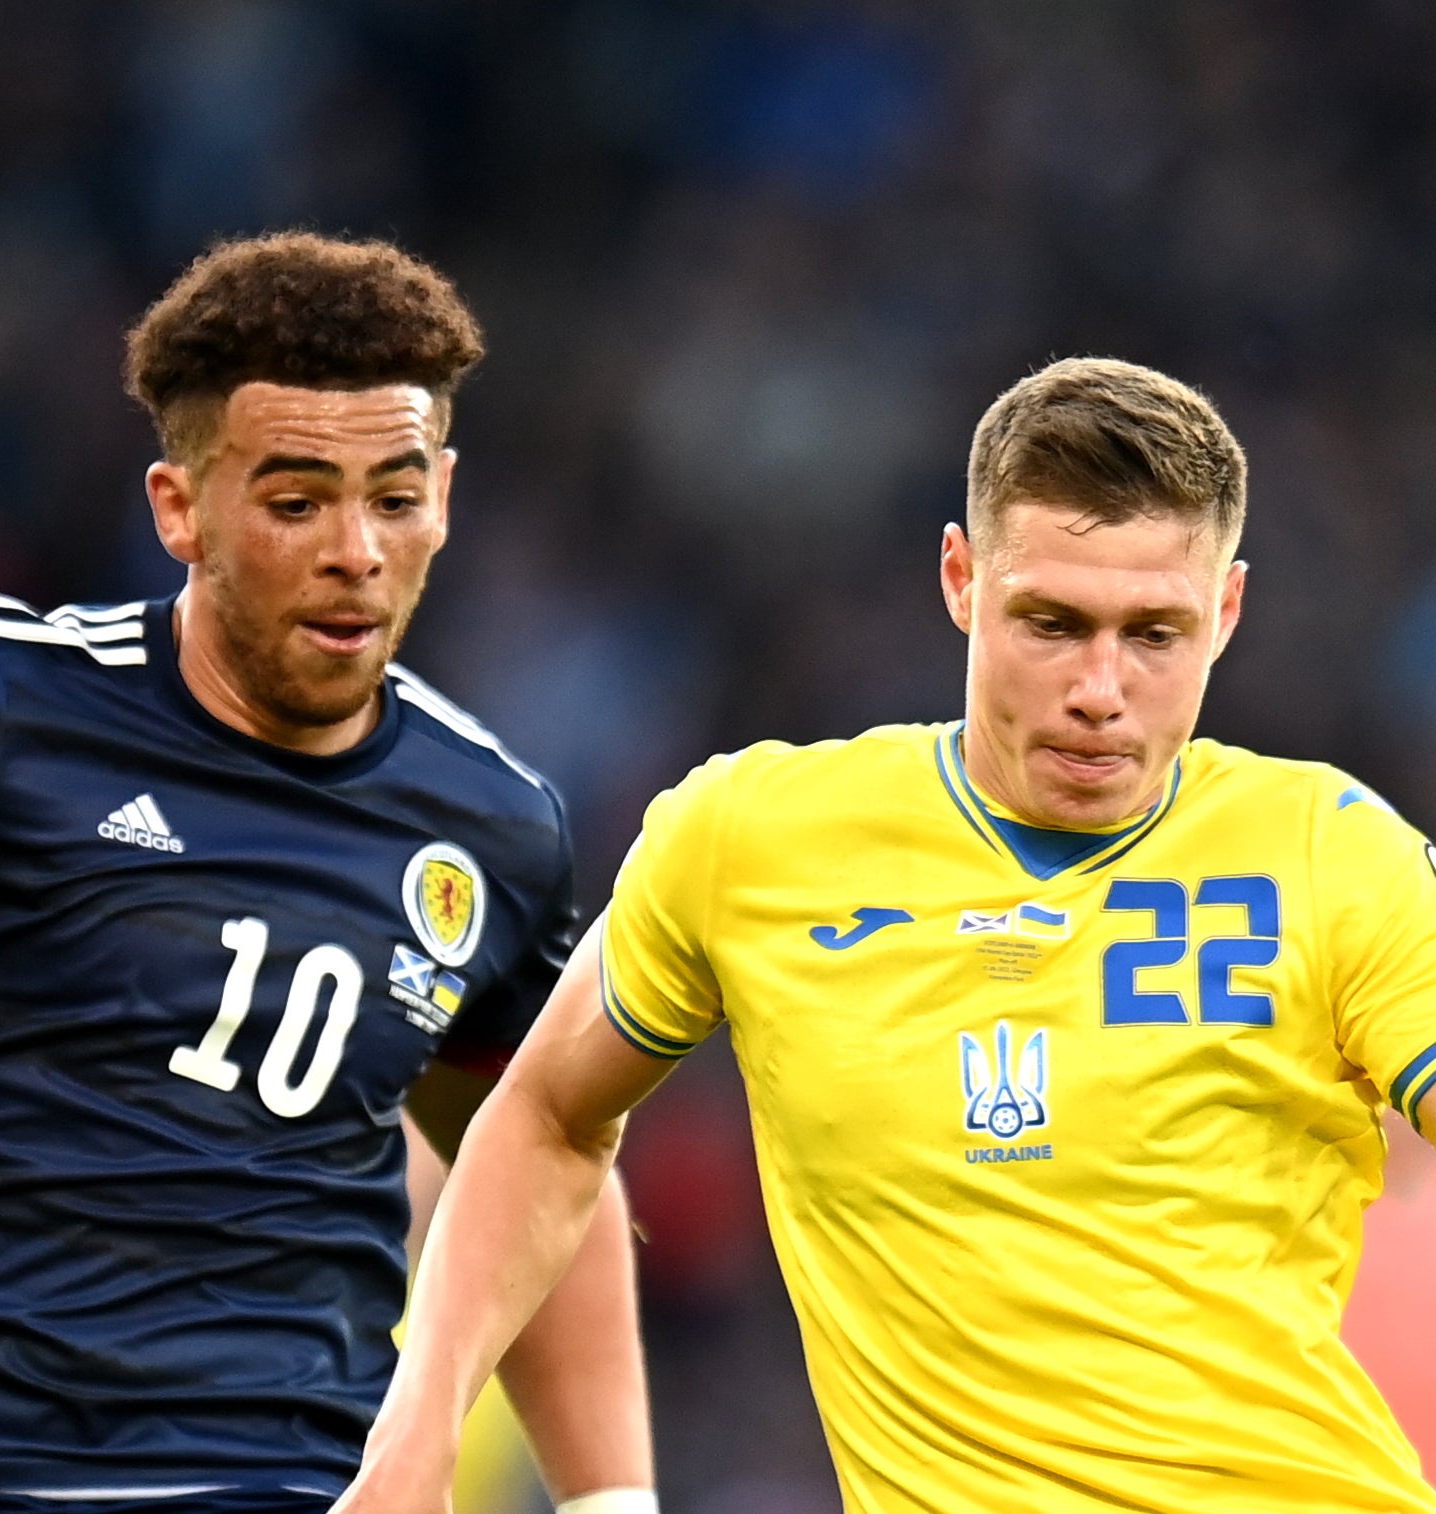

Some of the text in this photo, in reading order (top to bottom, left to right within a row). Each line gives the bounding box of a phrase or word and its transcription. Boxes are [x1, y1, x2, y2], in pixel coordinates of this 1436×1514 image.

[98, 819, 186, 854] adidas
[1099, 872, 1282, 1029] 22
[168, 917, 364, 1119] 10
[964, 1143, 1054, 1165] UKRAINE
